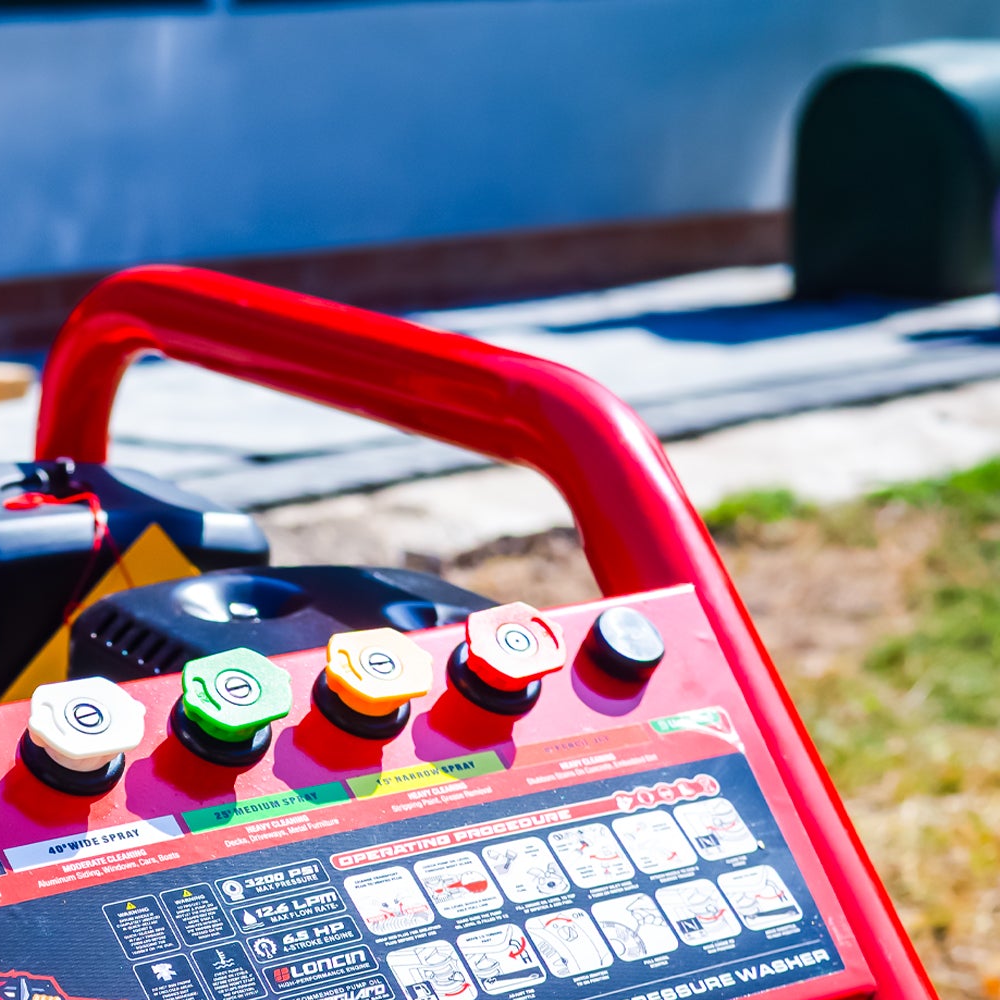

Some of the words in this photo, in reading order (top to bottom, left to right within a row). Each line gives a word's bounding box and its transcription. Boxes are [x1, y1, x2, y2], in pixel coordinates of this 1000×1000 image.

[395, 768, 440, 783] NARROW
[441, 761, 475, 773] SPRAY
[408, 790, 431, 800] HEAVY
[432, 782, 468, 795] CLEANING
[233, 800, 280, 816] MEDIUM
[283, 792, 318, 806] SPRAY
[224, 837, 249, 848] Decks,
[249, 829, 288, 842] Driveways,
[289, 825, 308, 835] Metal
[308, 818, 339, 831] Furniture
[245, 822, 271, 833] HEAVY
[271, 815, 309, 828] CLEANING
[102, 829, 140, 844] SPRAY
[338, 836, 451, 867] OPERATING
[453, 809, 572, 842] PROCEDURE
[38, 874, 76, 888] Aluminum
[77, 868, 103, 880] Siding,
[103, 862, 139, 875] Windows,
[139, 856, 159, 867] Cars,
[159, 851, 180, 862] Boats
[62, 857, 106, 873] MODERATE
[107, 849, 147, 864] CLEANING
[244, 872, 284, 888] 3200
[288, 864, 319, 878] PSI
[256, 884, 274, 893] MAX
[275, 874, 318, 889] PRESSURE
[256, 903, 289, 918] 12.6
[292, 892, 338, 910] LPM
[270, 913, 289, 923] MAX
[290, 908, 313, 919] FLOW
[283, 930, 309, 945] 6.5
[312, 922, 345, 938] HP
[283, 939, 323, 952] 4-STROKE
[324, 932, 354, 943] ENGINE
[278, 968, 345, 989] HIGH-PERFORMANCE
[345, 963, 370, 973] ENGINE
[291, 950, 366, 978] LONCIN
[736, 948, 830, 983] WASHER
[345, 982, 367, 992] PUMP
